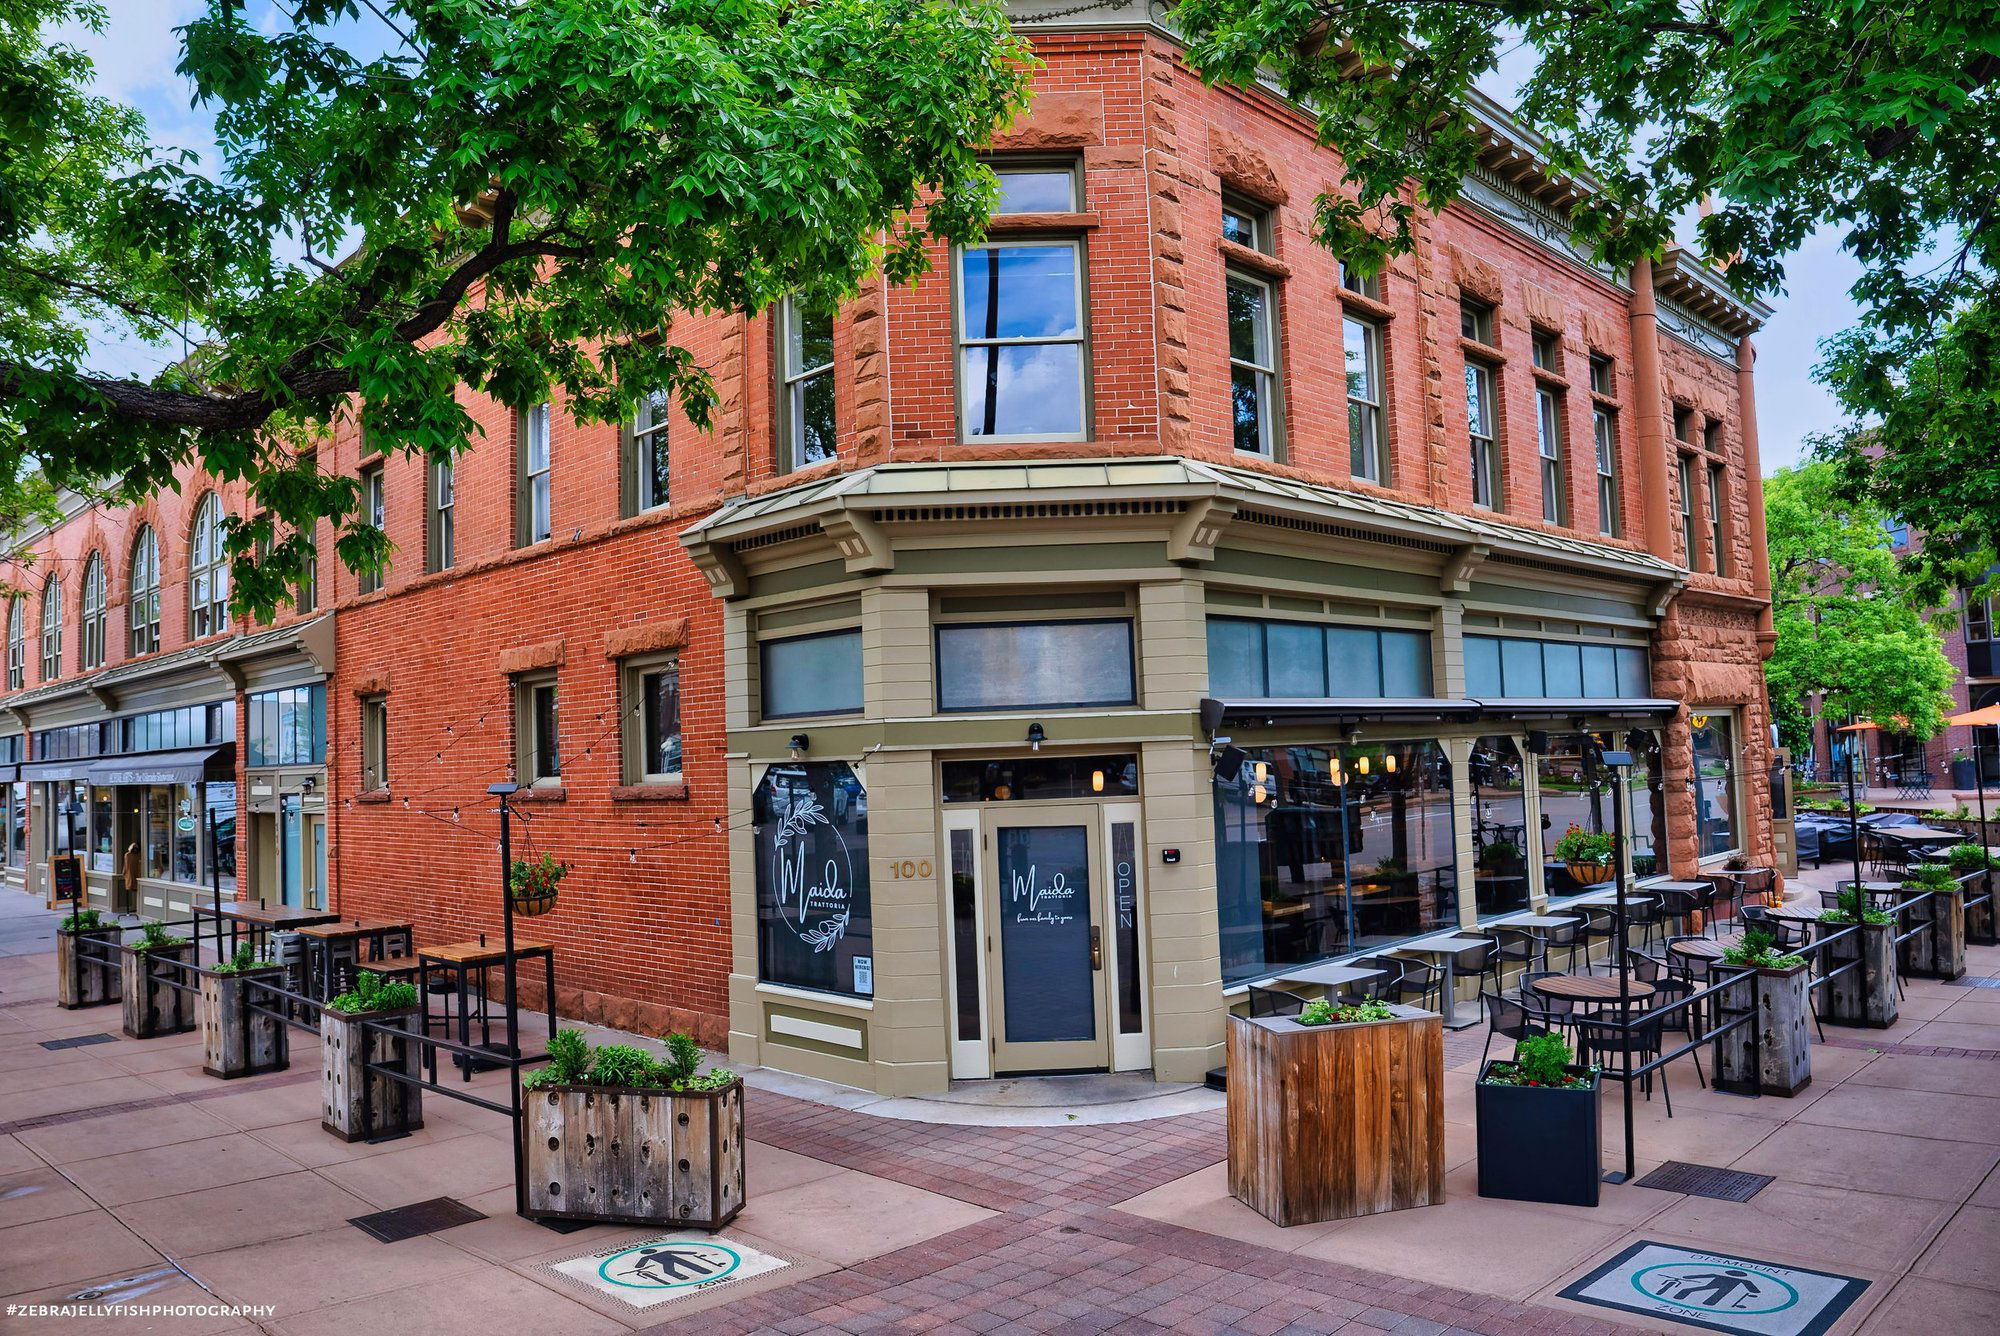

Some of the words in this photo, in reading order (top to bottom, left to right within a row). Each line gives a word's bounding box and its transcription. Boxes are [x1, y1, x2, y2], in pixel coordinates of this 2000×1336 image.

[889, 860, 933, 879] 100
[780, 840, 848, 924] Maida
[1012, 864, 1076, 912] Maida
[809, 900, 846, 910] TRATTORIA
[1117, 861, 1132, 929] OPEN
[593, 1236, 669, 1259] DISMOUNT
[1689, 1253, 1795, 1277] DISMOUNT
[695, 1274, 737, 1290] ZONE
[1654, 1302, 1711, 1320] ZONE
